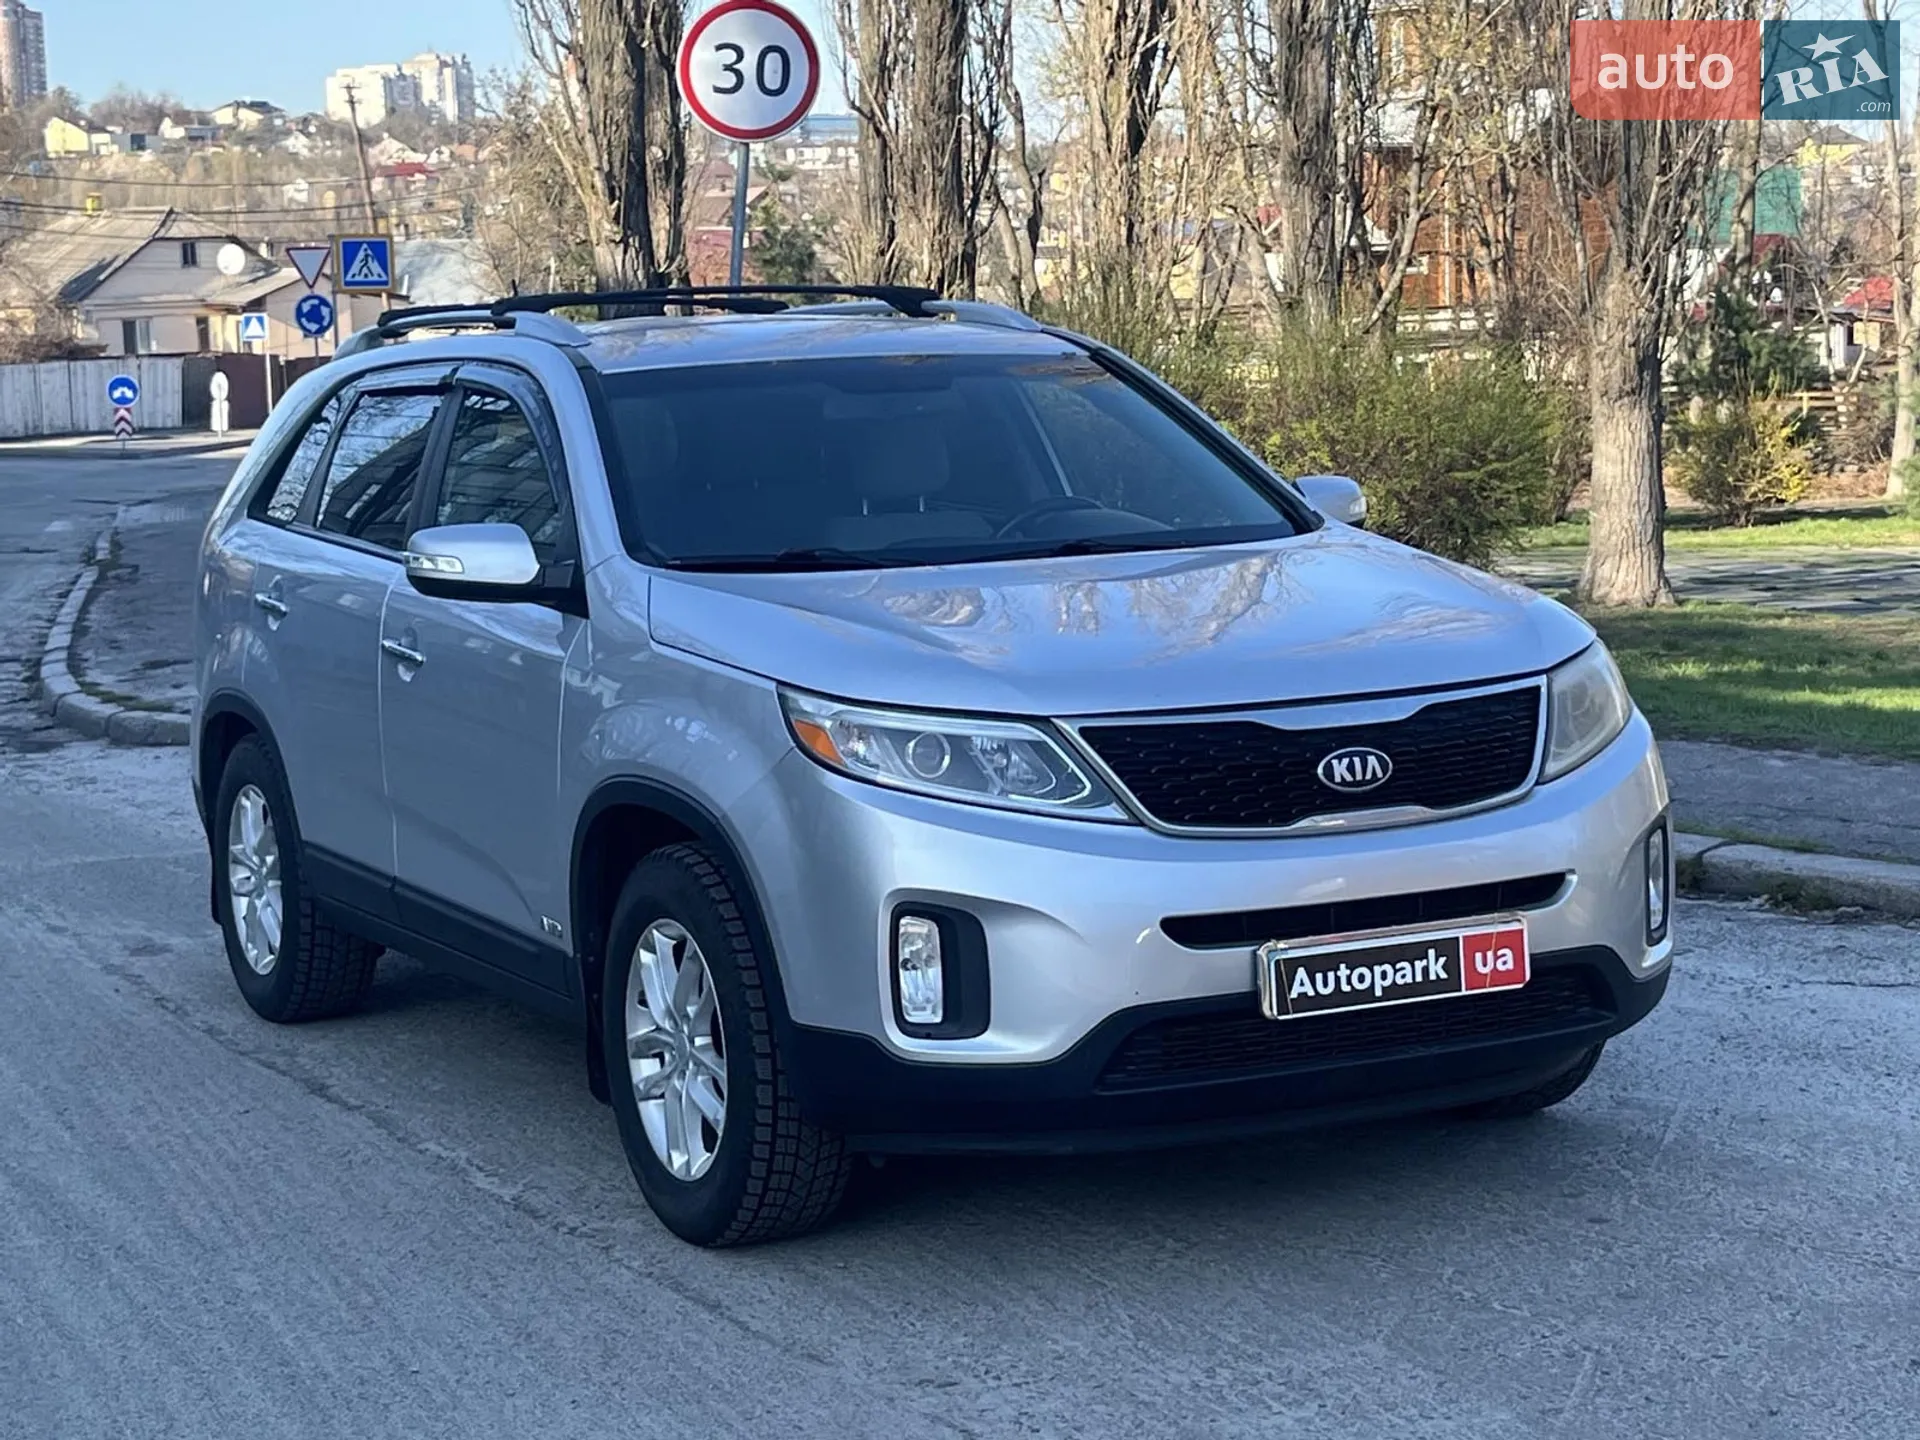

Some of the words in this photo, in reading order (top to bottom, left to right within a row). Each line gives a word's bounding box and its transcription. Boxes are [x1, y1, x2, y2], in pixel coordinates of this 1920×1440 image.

[712, 42, 791, 97] 30
[1331, 755, 1384, 783] KIA
[1289, 949, 1449, 999] Autopark
[1474, 947, 1514, 975] ua
